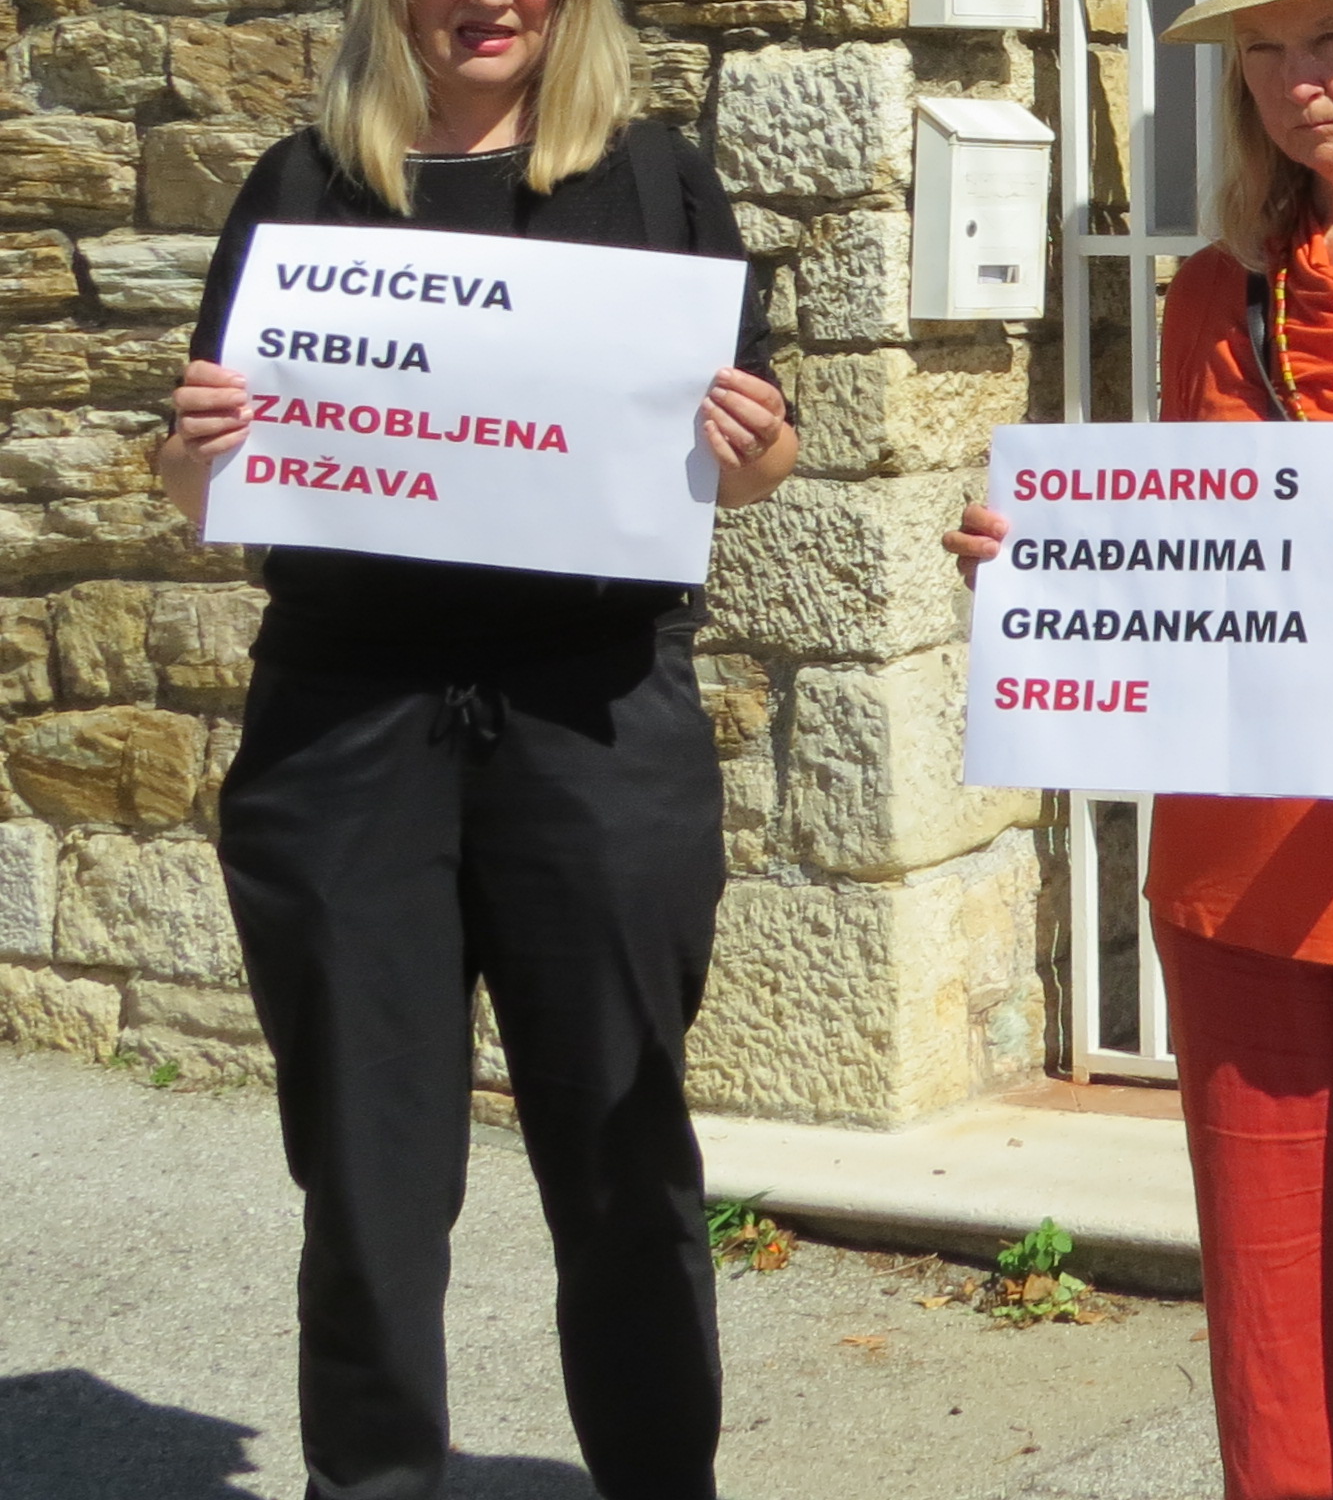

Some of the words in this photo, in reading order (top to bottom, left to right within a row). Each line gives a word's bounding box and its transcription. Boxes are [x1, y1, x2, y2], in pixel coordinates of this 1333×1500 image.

[276, 260, 513, 311] VUČIĆEVA
[257, 328, 431, 373] SRBIJA
[251, 394, 569, 453] ZAROBLJENA
[245, 455, 439, 501] DRŽAVA
[1013, 468, 1259, 501] SOLIDARNO
[1274, 468, 1299, 500] S
[1011, 539, 1265, 571] GRAĐANIMA
[1281, 539, 1292, 571] I
[1002, 608, 1308, 643] GRAĐANKAMA
[995, 678, 1149, 713] SRBIJE
